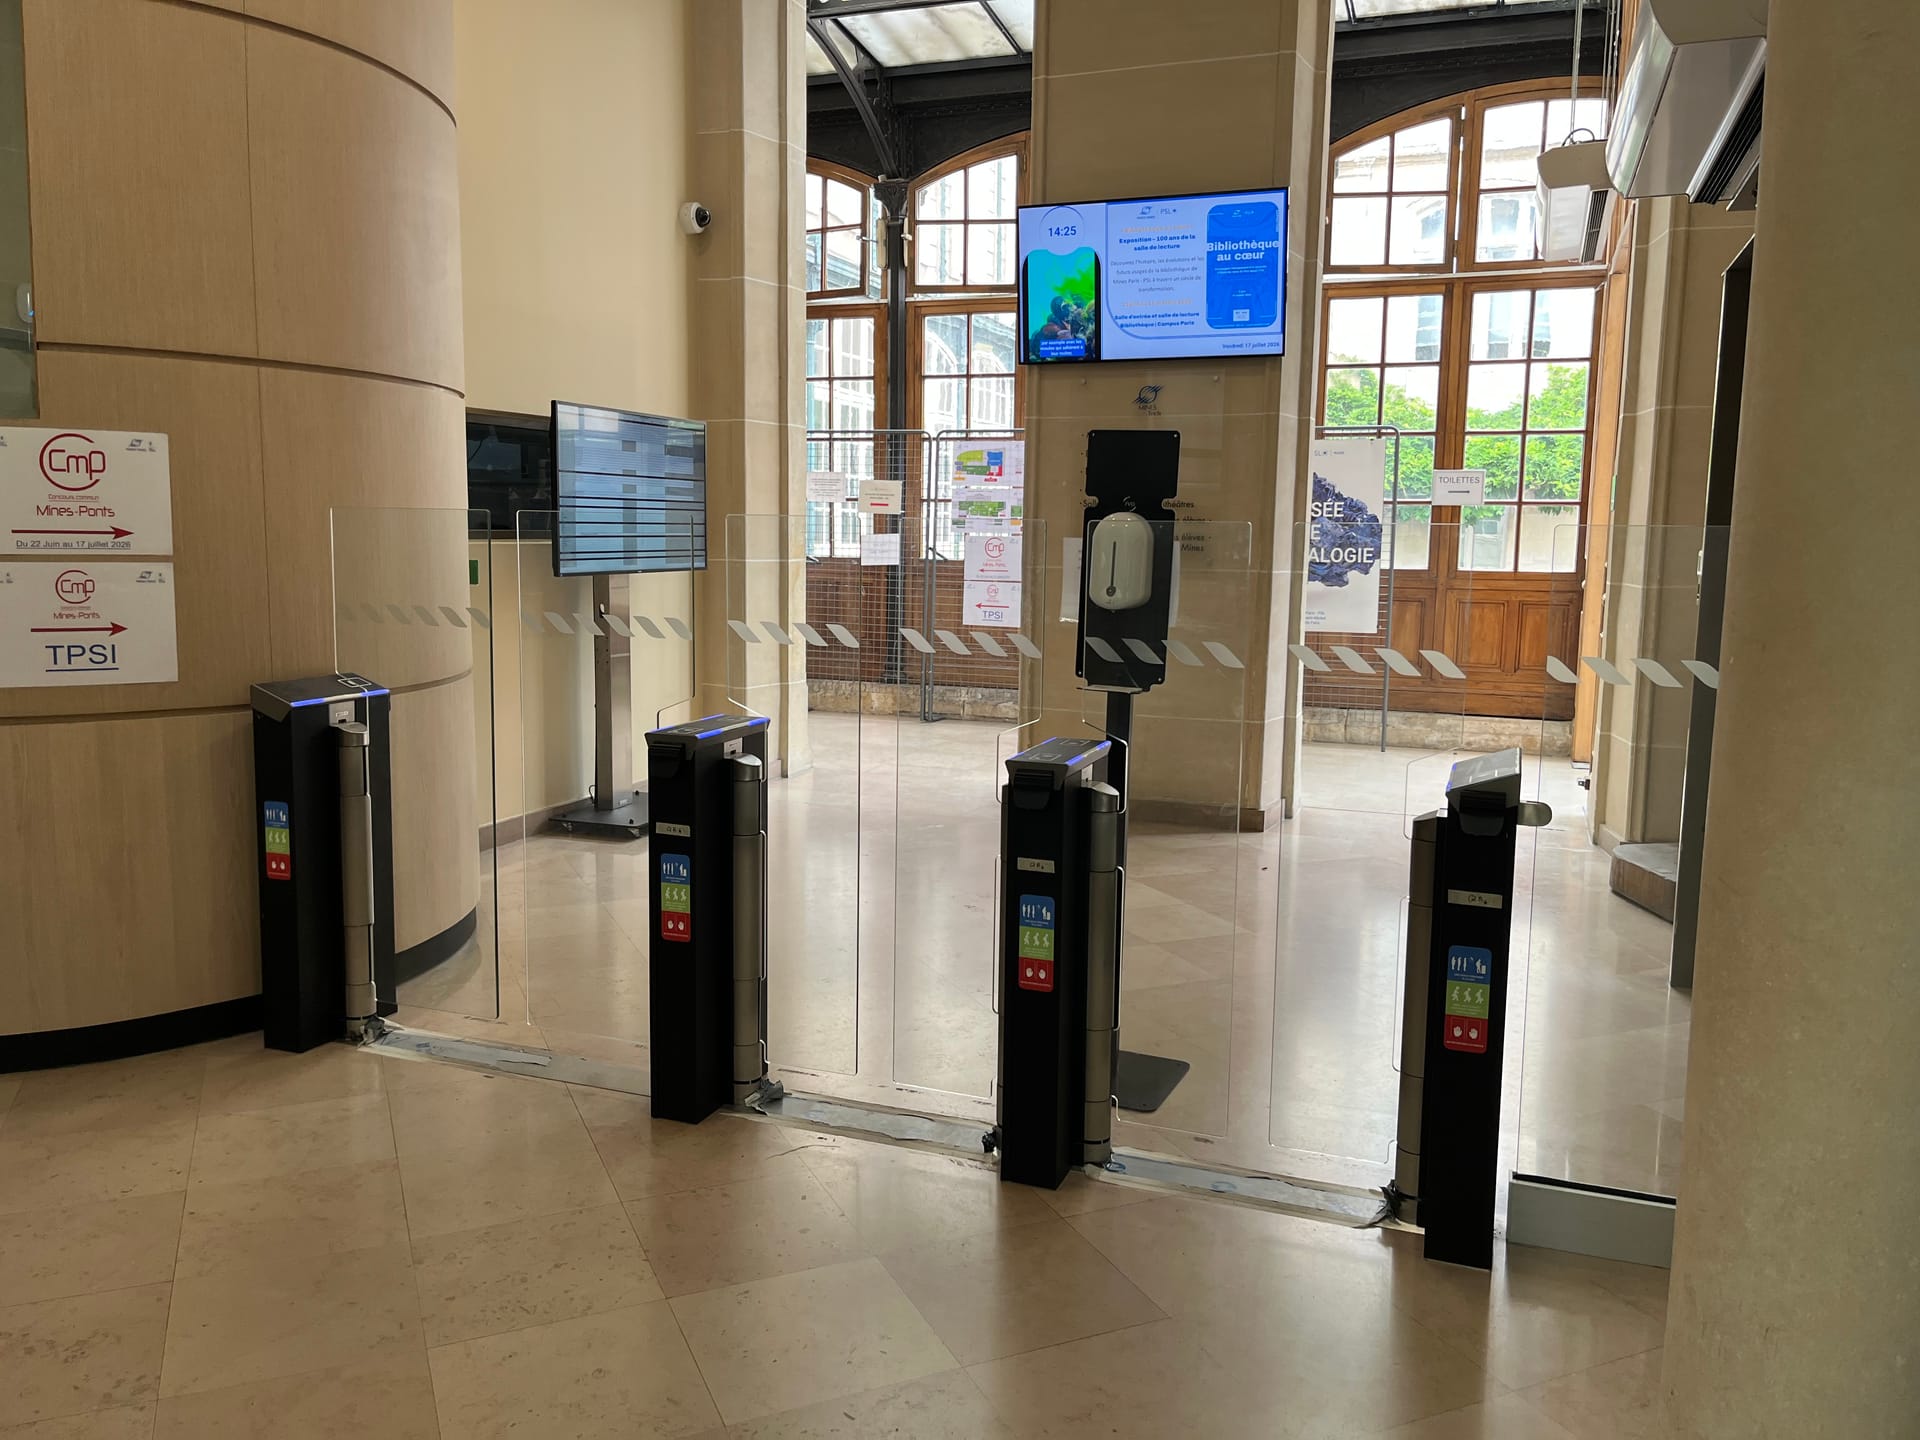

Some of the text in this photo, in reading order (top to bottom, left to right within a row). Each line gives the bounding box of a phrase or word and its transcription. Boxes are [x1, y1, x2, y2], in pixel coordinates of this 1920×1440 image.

[1048, 226, 1077, 237] 14:25
[1216, 252, 1264, 262] au cœur
[1439, 476, 1480, 484] TOILETTES
[36, 505, 116, 518] Mines-Ponts
[1311, 498, 1344, 518] SÉE
[16, 540, 28, 548] Du
[30, 540, 40, 548] 22
[88, 540, 108, 549] juillet
[1310, 547, 1374, 563] ALOGIE
[53, 612, 100, 620] Mines-Ponts
[982, 610, 1004, 620] TPSI
[45, 644, 116, 665] TPSI
